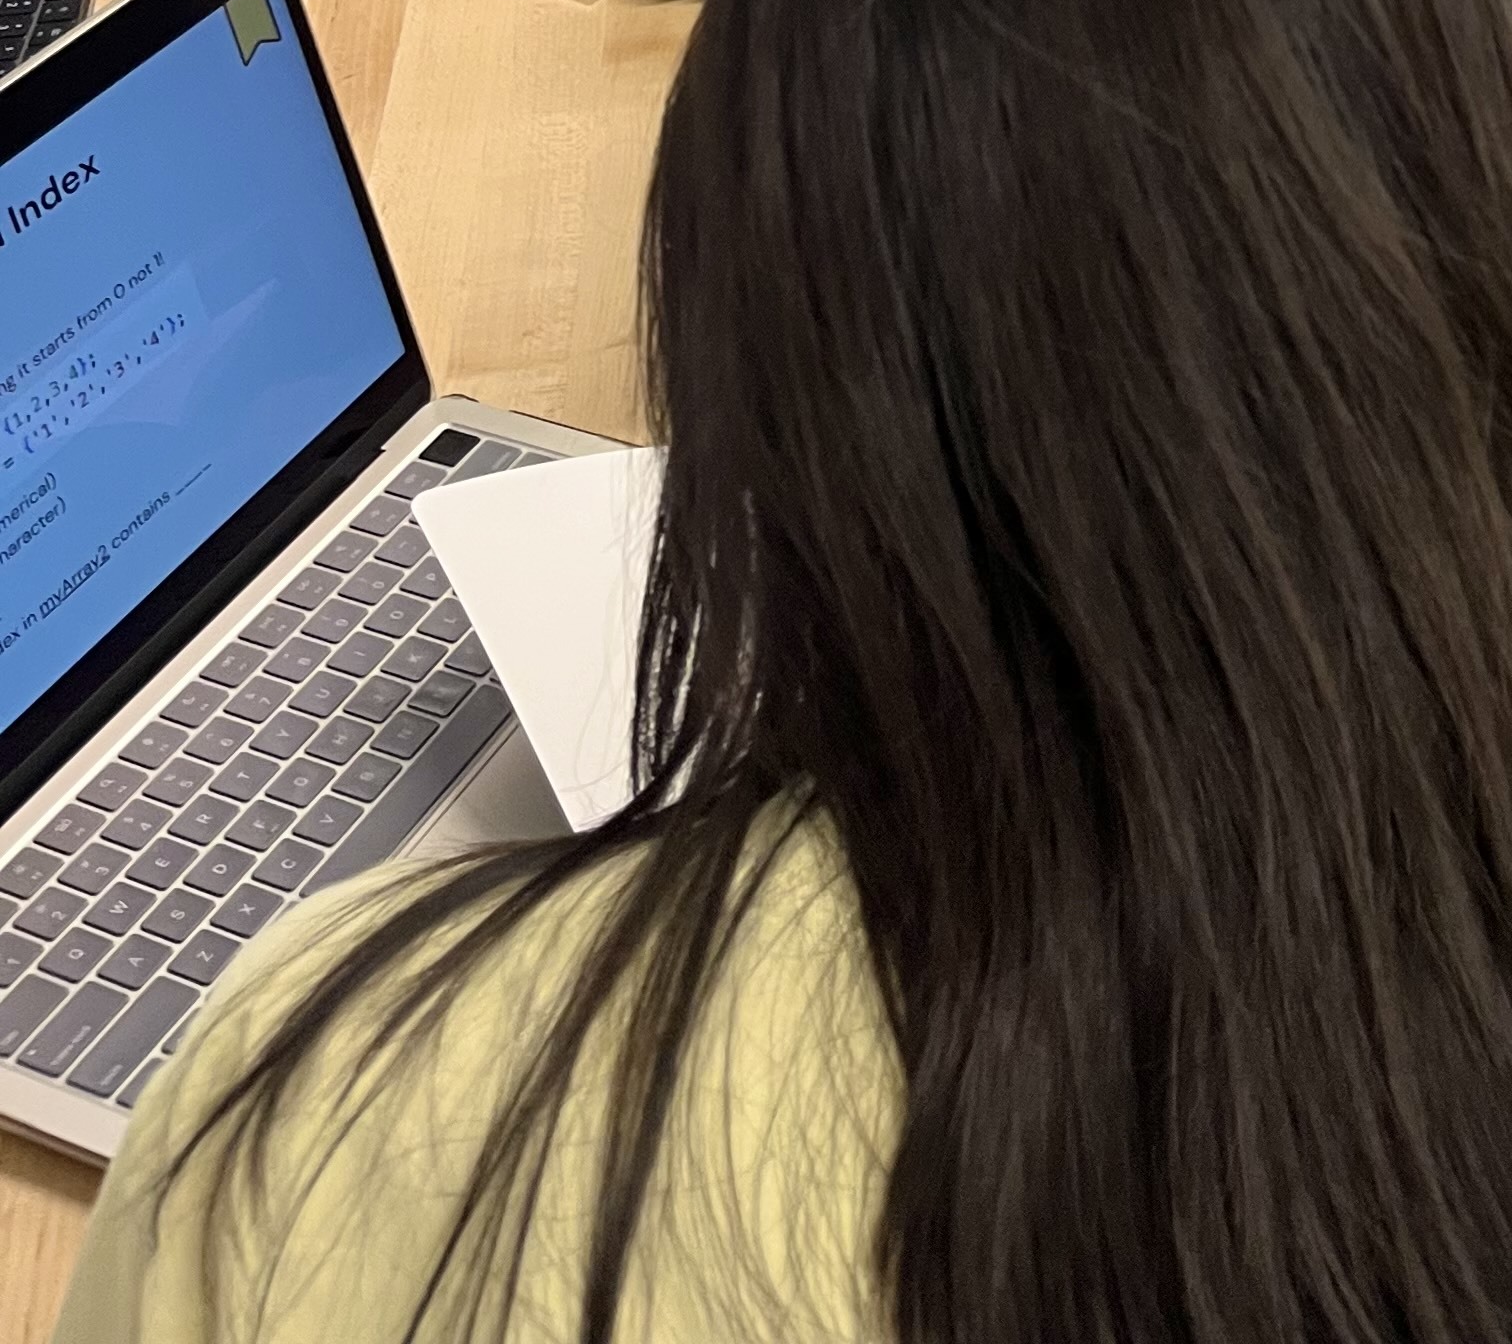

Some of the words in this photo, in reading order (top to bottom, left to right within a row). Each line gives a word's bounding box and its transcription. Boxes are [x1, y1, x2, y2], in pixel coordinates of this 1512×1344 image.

[7, 154, 101, 234] Index
[32, 326, 76, 367] starts
[76, 296, 113, 330] from
[128, 262, 154, 289] not
[22, 613, 38, 630] in
[39, 544, 111, 620] myArray2
[111, 491, 171, 550] contains
